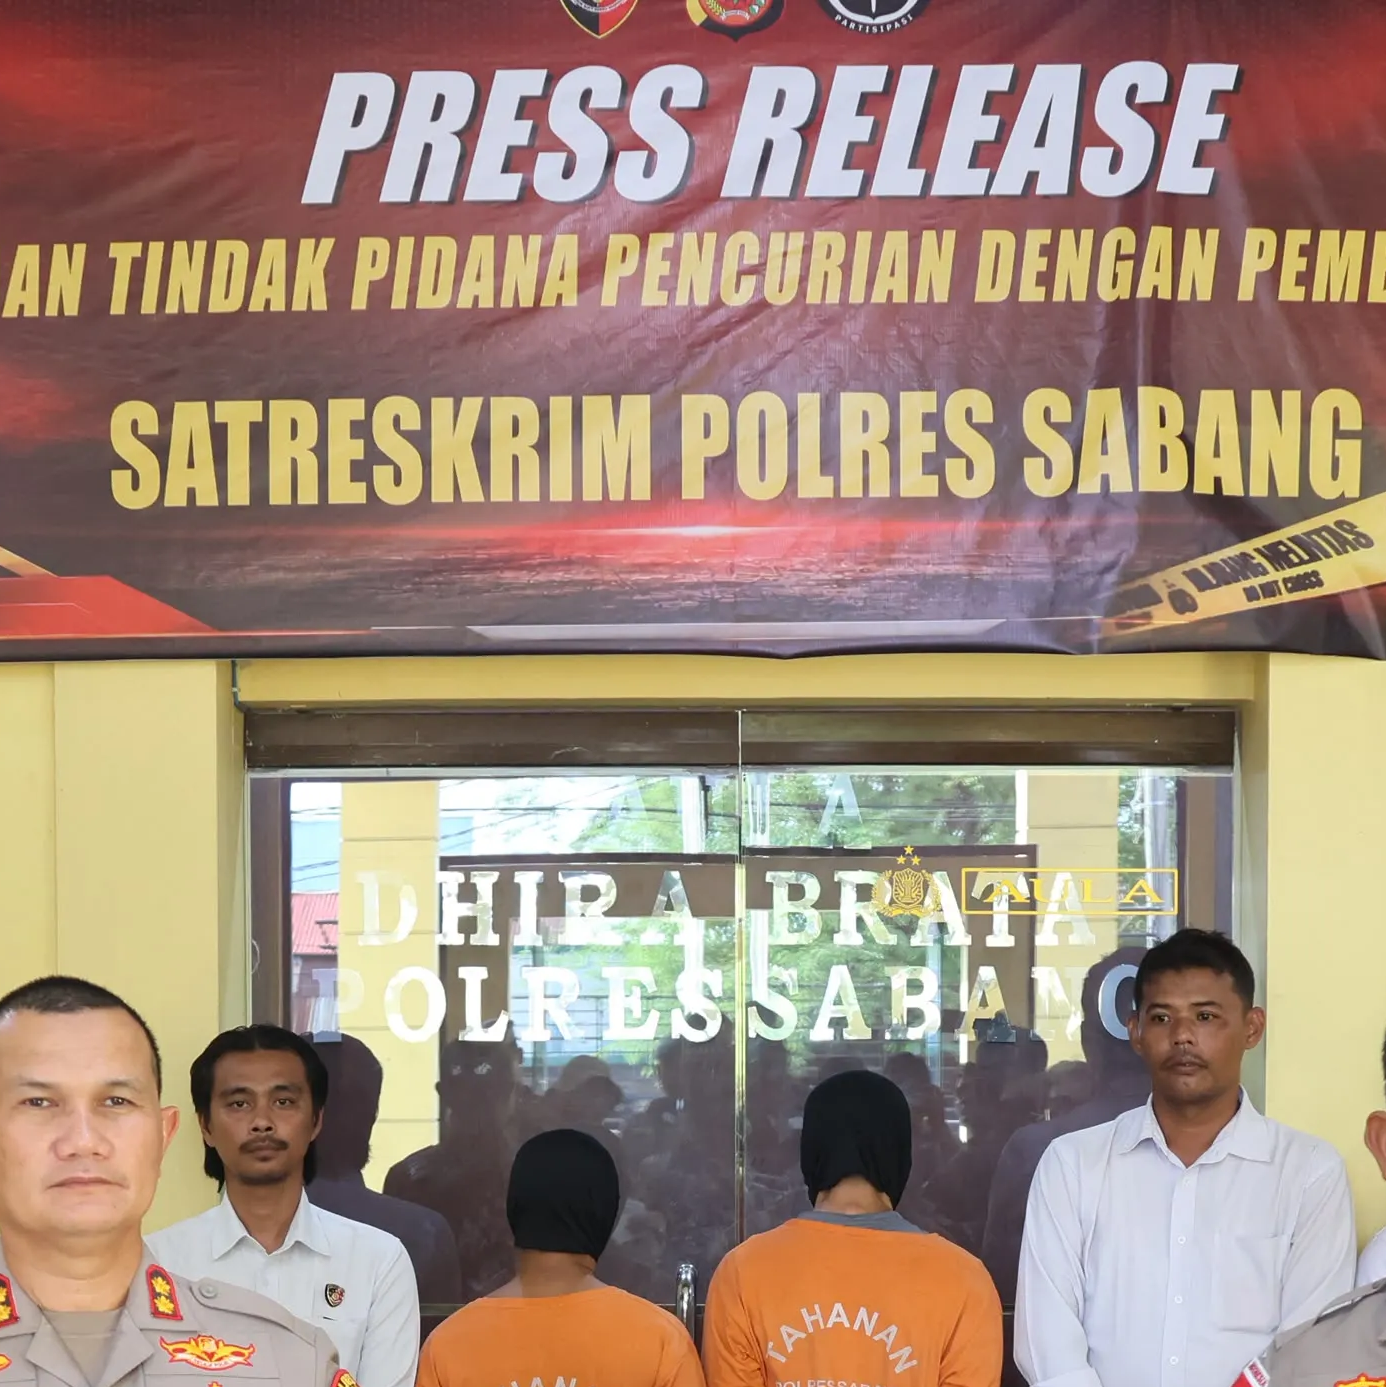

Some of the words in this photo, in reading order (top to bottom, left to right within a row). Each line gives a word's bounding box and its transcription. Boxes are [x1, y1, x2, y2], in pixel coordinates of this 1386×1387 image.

[834, 14, 914, 34] PARTISIPASI
[300, 64, 705, 205] PRESS
[720, 61, 1241, 199] RELEASE
[108, 237, 336, 316] TINDAK
[351, 233, 579, 312] PIDANA
[600, 228, 956, 307] PENCURIAN
[974, 226, 1221, 304] DENGAN
[109, 394, 653, 510] SATRESKRIM
[681, 387, 996, 502] POLRES
[1022, 387, 1364, 499] SABANG
[355, 869, 699, 947] DHIRA
[764, 868, 1097, 948] BRATA
[983, 878, 1165, 903] AULA
[311, 963, 724, 1044] POLRES
[765, 1302, 918, 1375] TAHANAN
